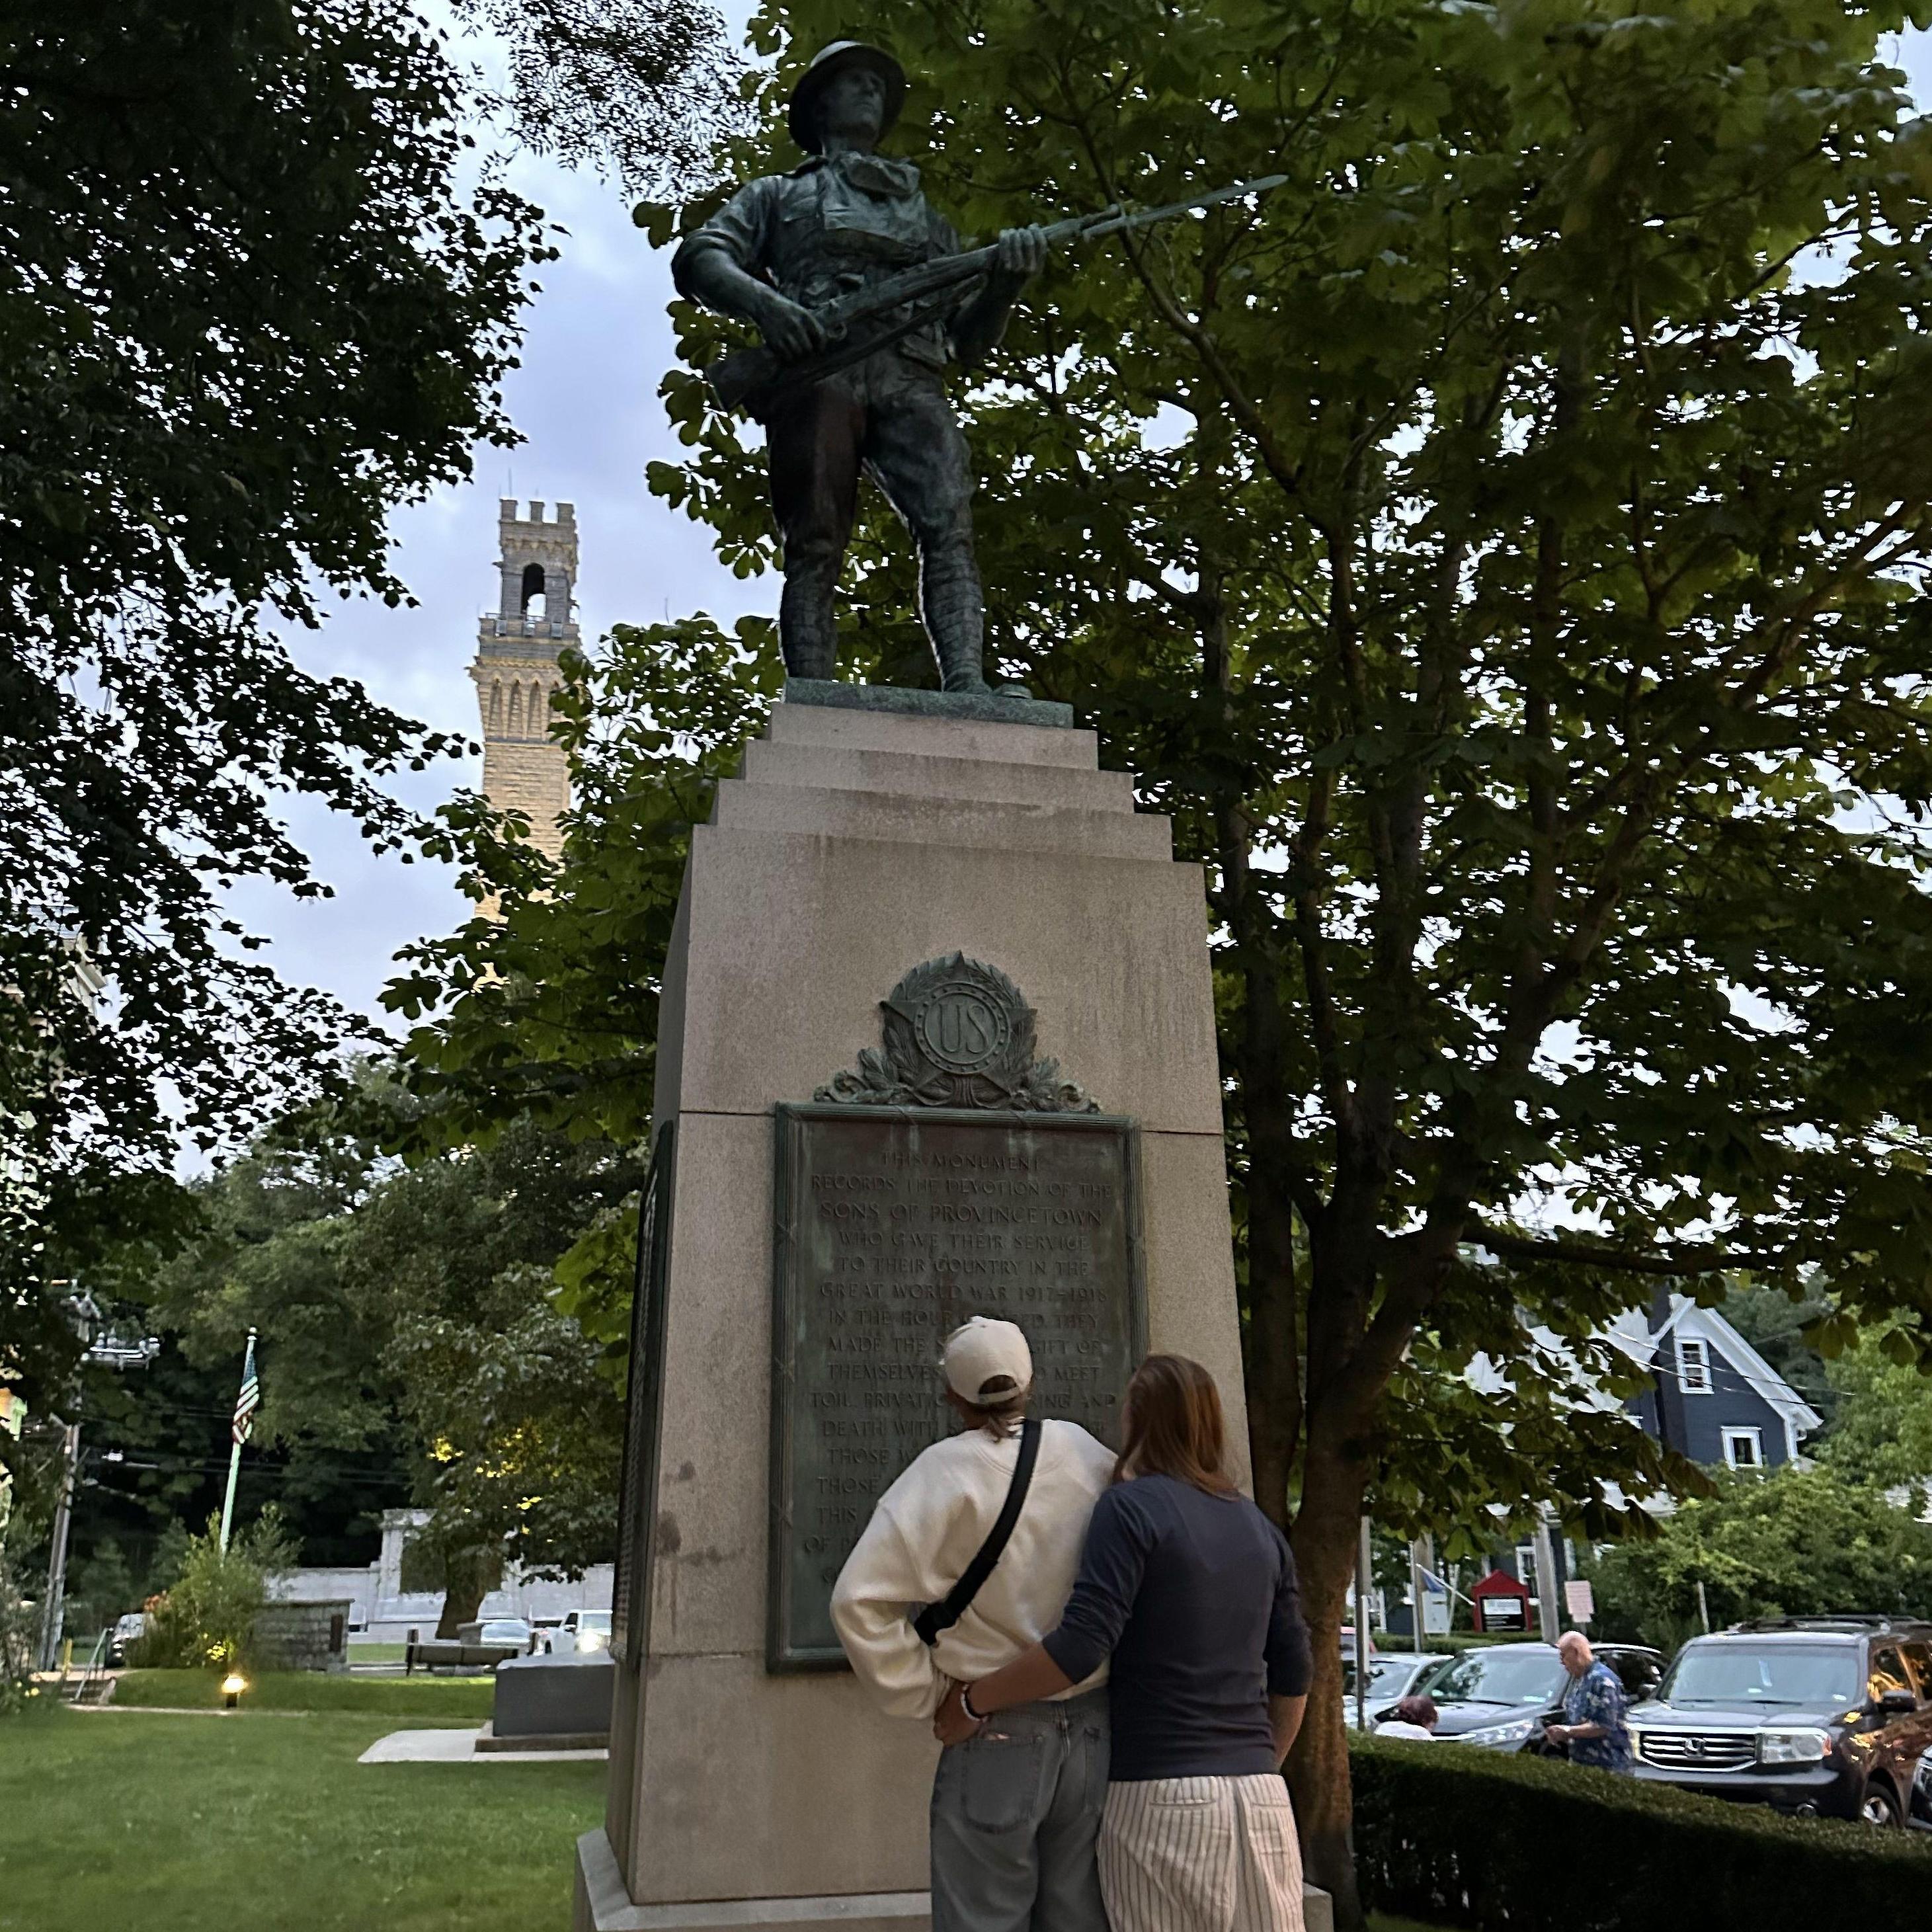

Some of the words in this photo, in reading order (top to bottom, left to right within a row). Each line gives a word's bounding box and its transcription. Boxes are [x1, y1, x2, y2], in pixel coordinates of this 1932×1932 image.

[938, 1002, 990, 1055] US
[880, 1151, 923, 1167] THIS
[934, 1152, 1041, 1171] MONUMENT
[811, 1174, 896, 1191] RECORDS
[906, 1177, 940, 1193] THE
[946, 1178, 1040, 1197] DEVOTION
[1047, 1182, 1072, 1197] OF
[1078, 1182, 1113, 1199] THE
[819, 1201, 879, 1221] SONS
[890, 1203, 919, 1223] OF
[930, 1204, 1103, 1227] PROVINCETOWN
[836, 1230, 883, 1246] WHO
[891, 1231, 940, 1248] GAVE
[949, 1232, 1003, 1250] THEIR
[1014, 1234, 1092, 1252] SERVICE
[840, 1256, 864, 1271] TO
[873, 1256, 926, 1273] THEIR
[934, 1258, 1020, 1276] COUNTRY
[1028, 1259, 1046, 1276] IN
[1056, 1260, 1090, 1277] THE
[819, 1281, 884, 1299] GREAT
[893, 1283, 963, 1301] WORLD
[969, 1285, 1007, 1301] WAR
[828, 1308, 847, 1325] IN
[858, 1308, 891, 1326] THE
[900, 1310, 952, 1327] HOUR
[1054, 1313, 1099, 1329] THEY
[827, 1336, 881, 1353] MADE
[893, 1337, 926, 1353] THE
[1076, 1340, 1102, 1355] OF
[1054, 1367, 1100, 1382] MEET
[1083, 1392, 1116, 1409] AND
[823, 1420, 883, 1437] DEATH
[893, 1421, 938, 1438] WITH
[828, 1448, 890, 1465] THOSE
[816, 1476, 881, 1494] THOSE
[815, 1506, 858, 1523] THIS
[803, 1534, 829, 1554] OF
